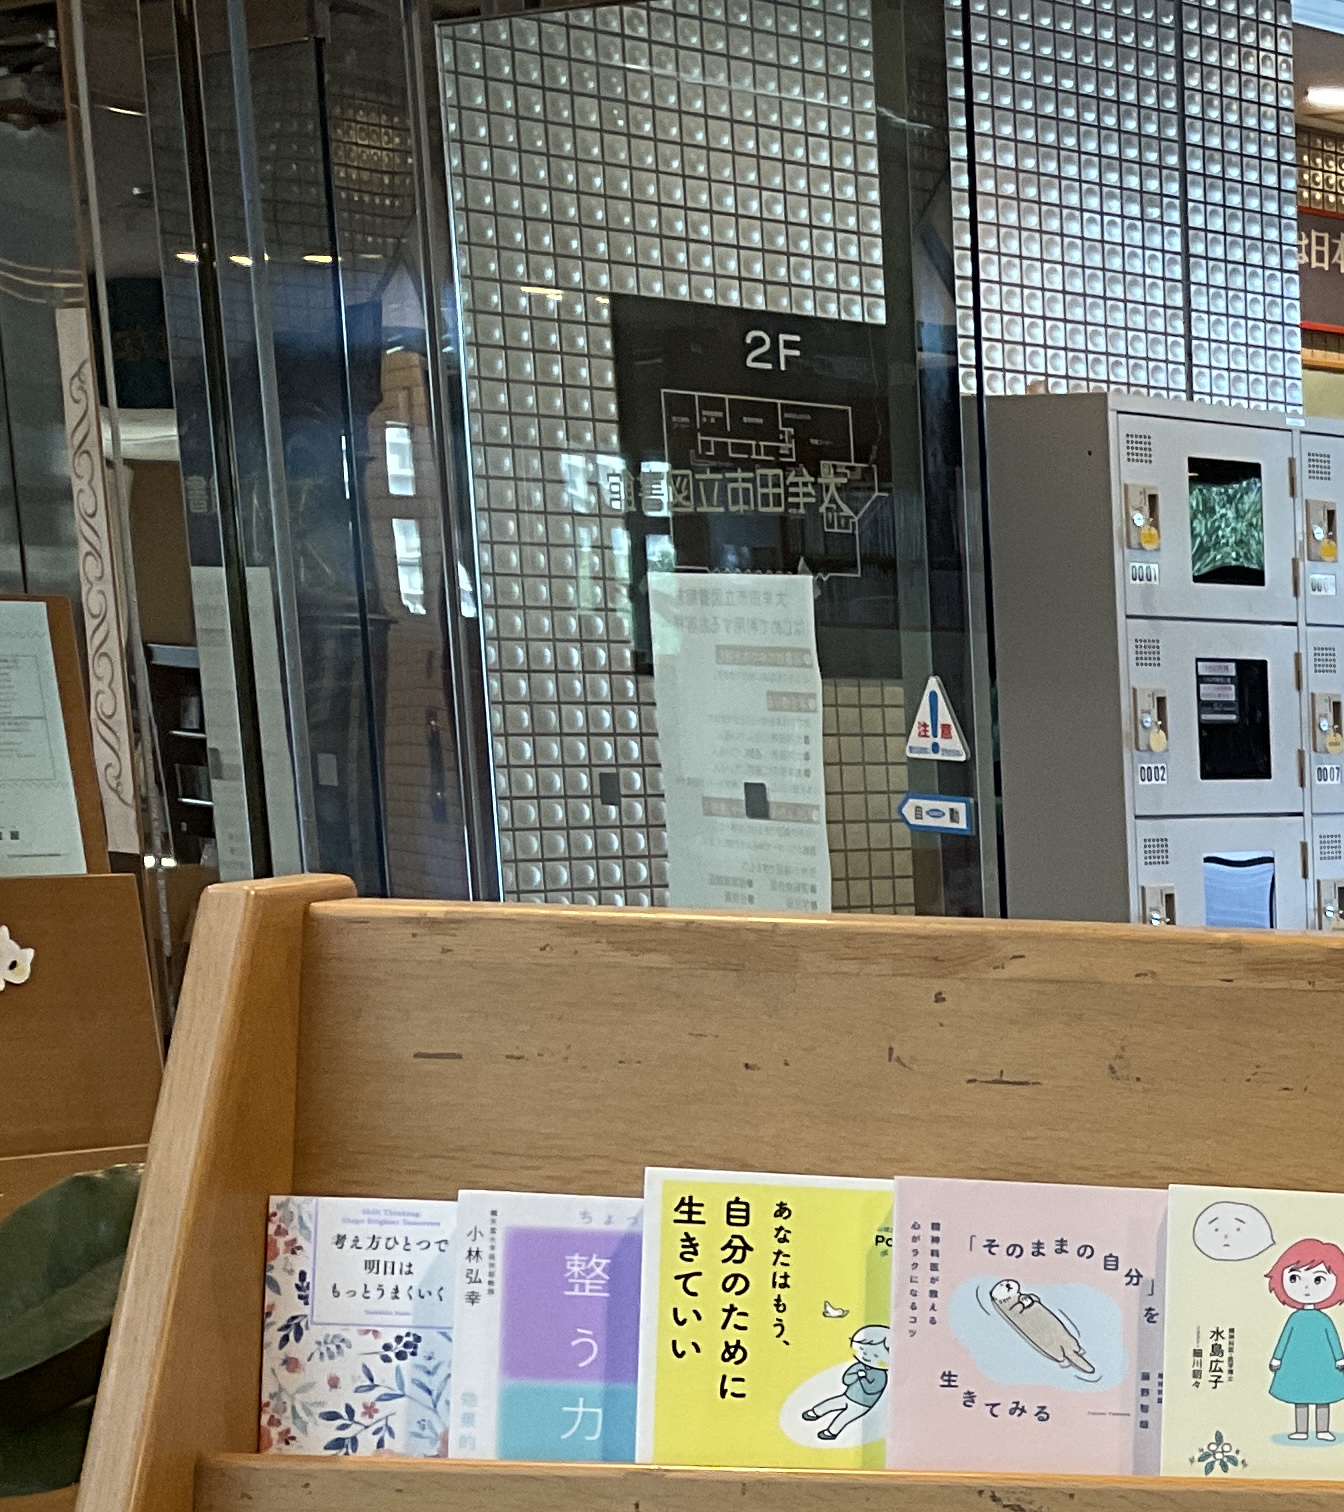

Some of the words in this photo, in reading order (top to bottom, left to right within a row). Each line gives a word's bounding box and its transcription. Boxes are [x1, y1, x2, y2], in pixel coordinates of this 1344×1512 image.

[745, 330, 801, 371] 2F
[1139, 765, 1166, 783] 0002
[1317, 765, 1341, 782] 0007
[333, 1233, 449, 1253] 考え方ひとつで
[363, 1259, 415, 1276] 明日は
[464, 1225, 485, 1306] 小林弘幸
[331, 1283, 445, 1302] もっとうまくいく
[671, 1195, 707, 1360] 生きていい
[718, 1195, 754, 1402] 自分のために
[771, 1200, 793, 1347] あなたはもう、
[907, 1221, 921, 1338] 心がラクになるコツ
[560, 1252, 612, 1442] 整う力
[1208, 1326, 1226, 1390] 水島広子
[939, 1370, 1051, 1422] 生きてみる
